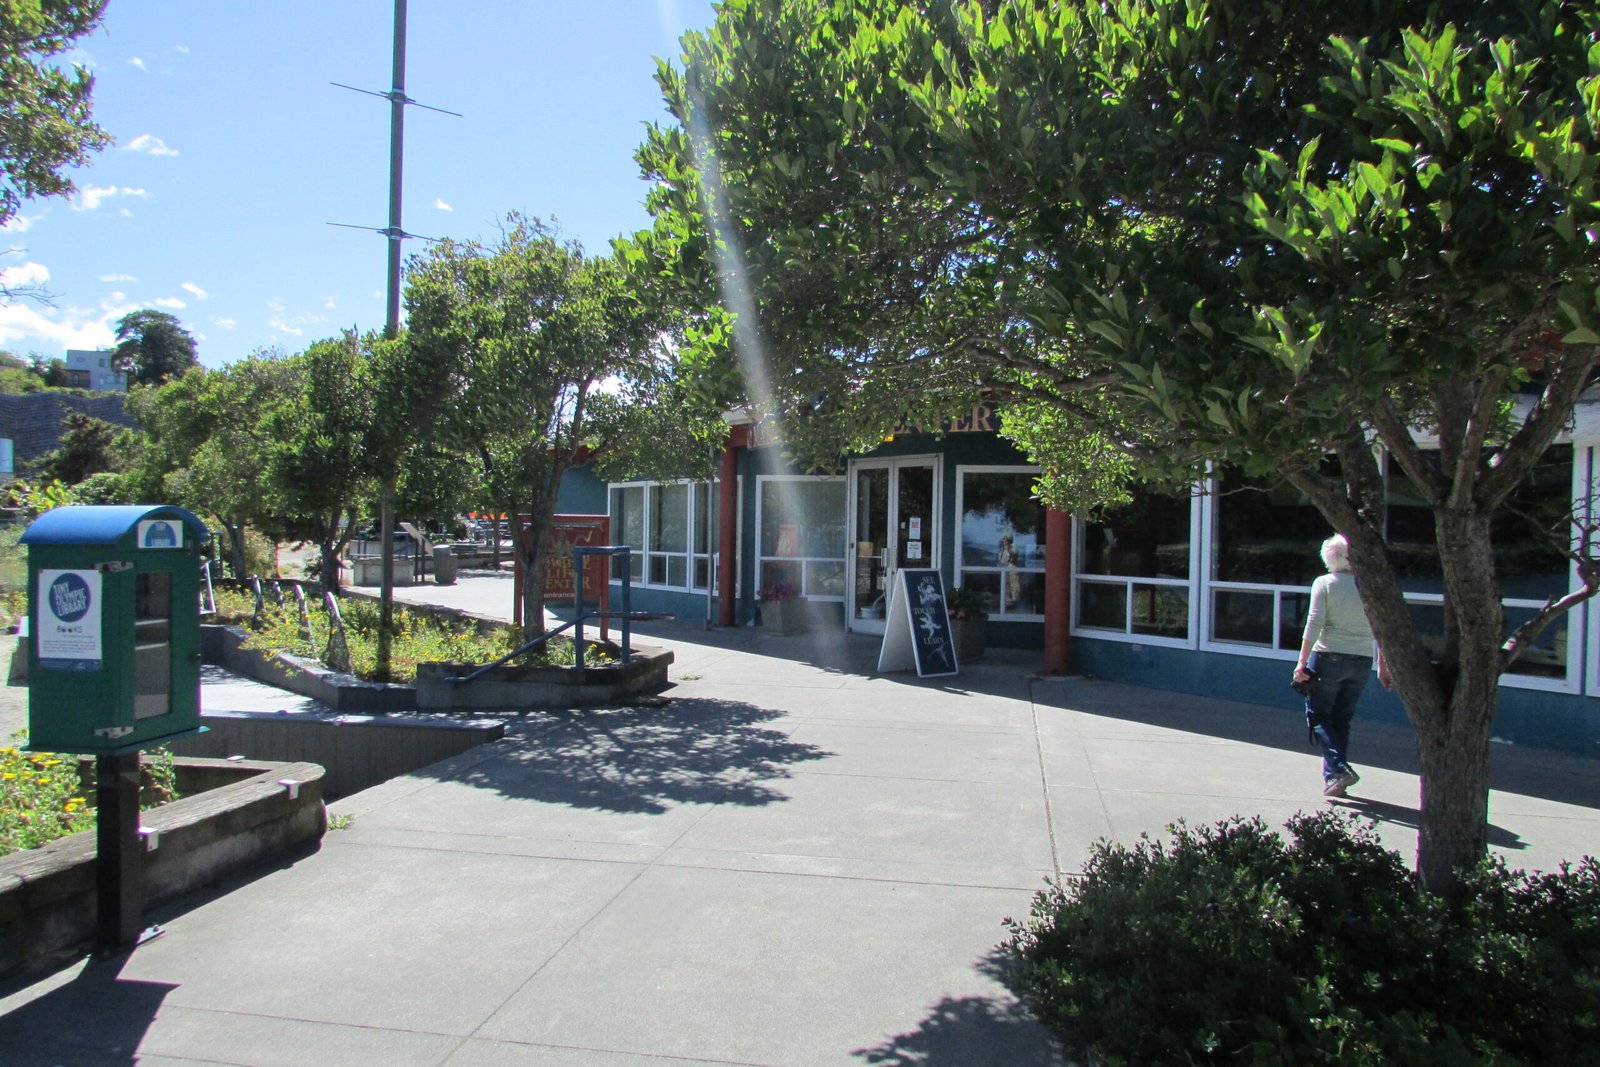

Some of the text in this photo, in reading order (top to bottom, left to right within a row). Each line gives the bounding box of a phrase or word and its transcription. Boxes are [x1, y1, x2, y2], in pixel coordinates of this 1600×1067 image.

[53, 581, 70, 594] TINY
[55, 587, 87, 606] OLYMPIC
[57, 596, 86, 617] LIBRARY
